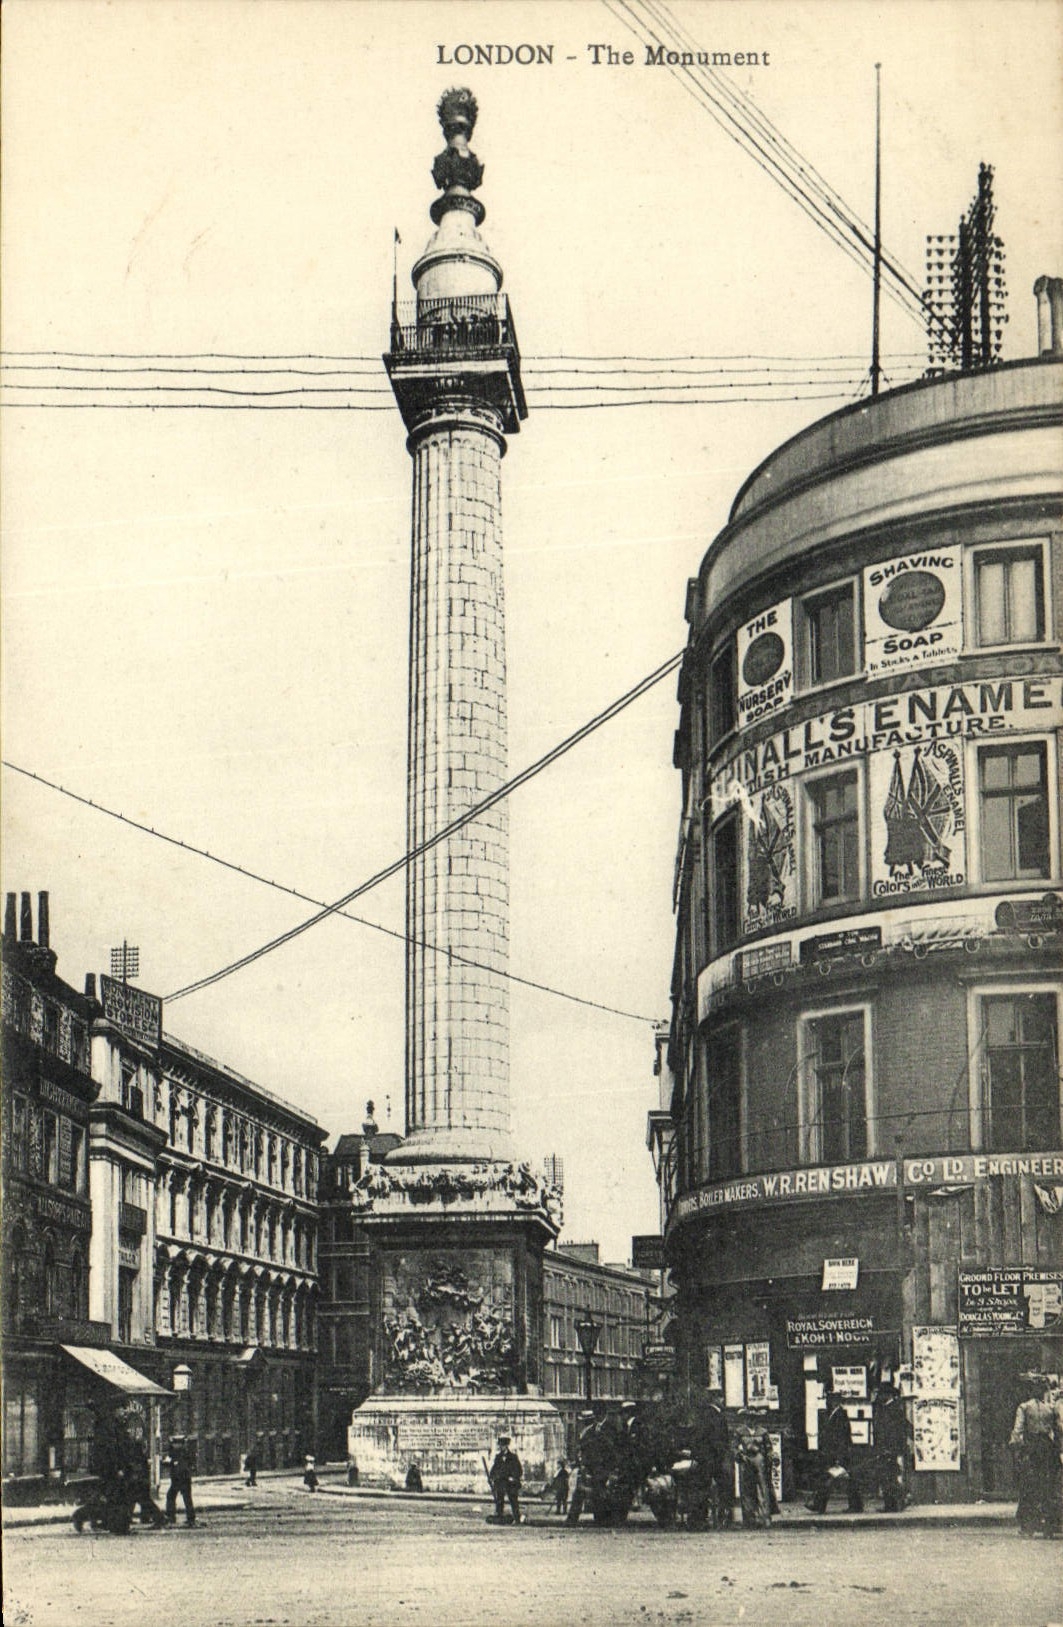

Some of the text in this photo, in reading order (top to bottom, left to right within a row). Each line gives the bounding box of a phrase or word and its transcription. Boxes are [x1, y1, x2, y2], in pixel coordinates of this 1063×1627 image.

[869, 556, 954, 587] SHAVING
[747, 610, 778, 638] THE
[884, 632, 943, 660] SOAP
[922, 646, 958, 660] Tablets
[739, 670, 792, 713] NURSERY
[746, 696, 784, 723] SOAP
[873, 679, 1063, 732] ENAME
[942, 783, 965, 837] ENAMEL
[873, 879, 911, 897] Colors
[926, 873, 964, 889] WORLD
[960, 1272, 993, 1282] GROUND
[994, 1272, 1021, 1281] FLOOR
[962, 1284, 982, 1296] TO
[992, 1283, 1020, 1296] LET
[787, 1321, 819, 1332] ROYAL
